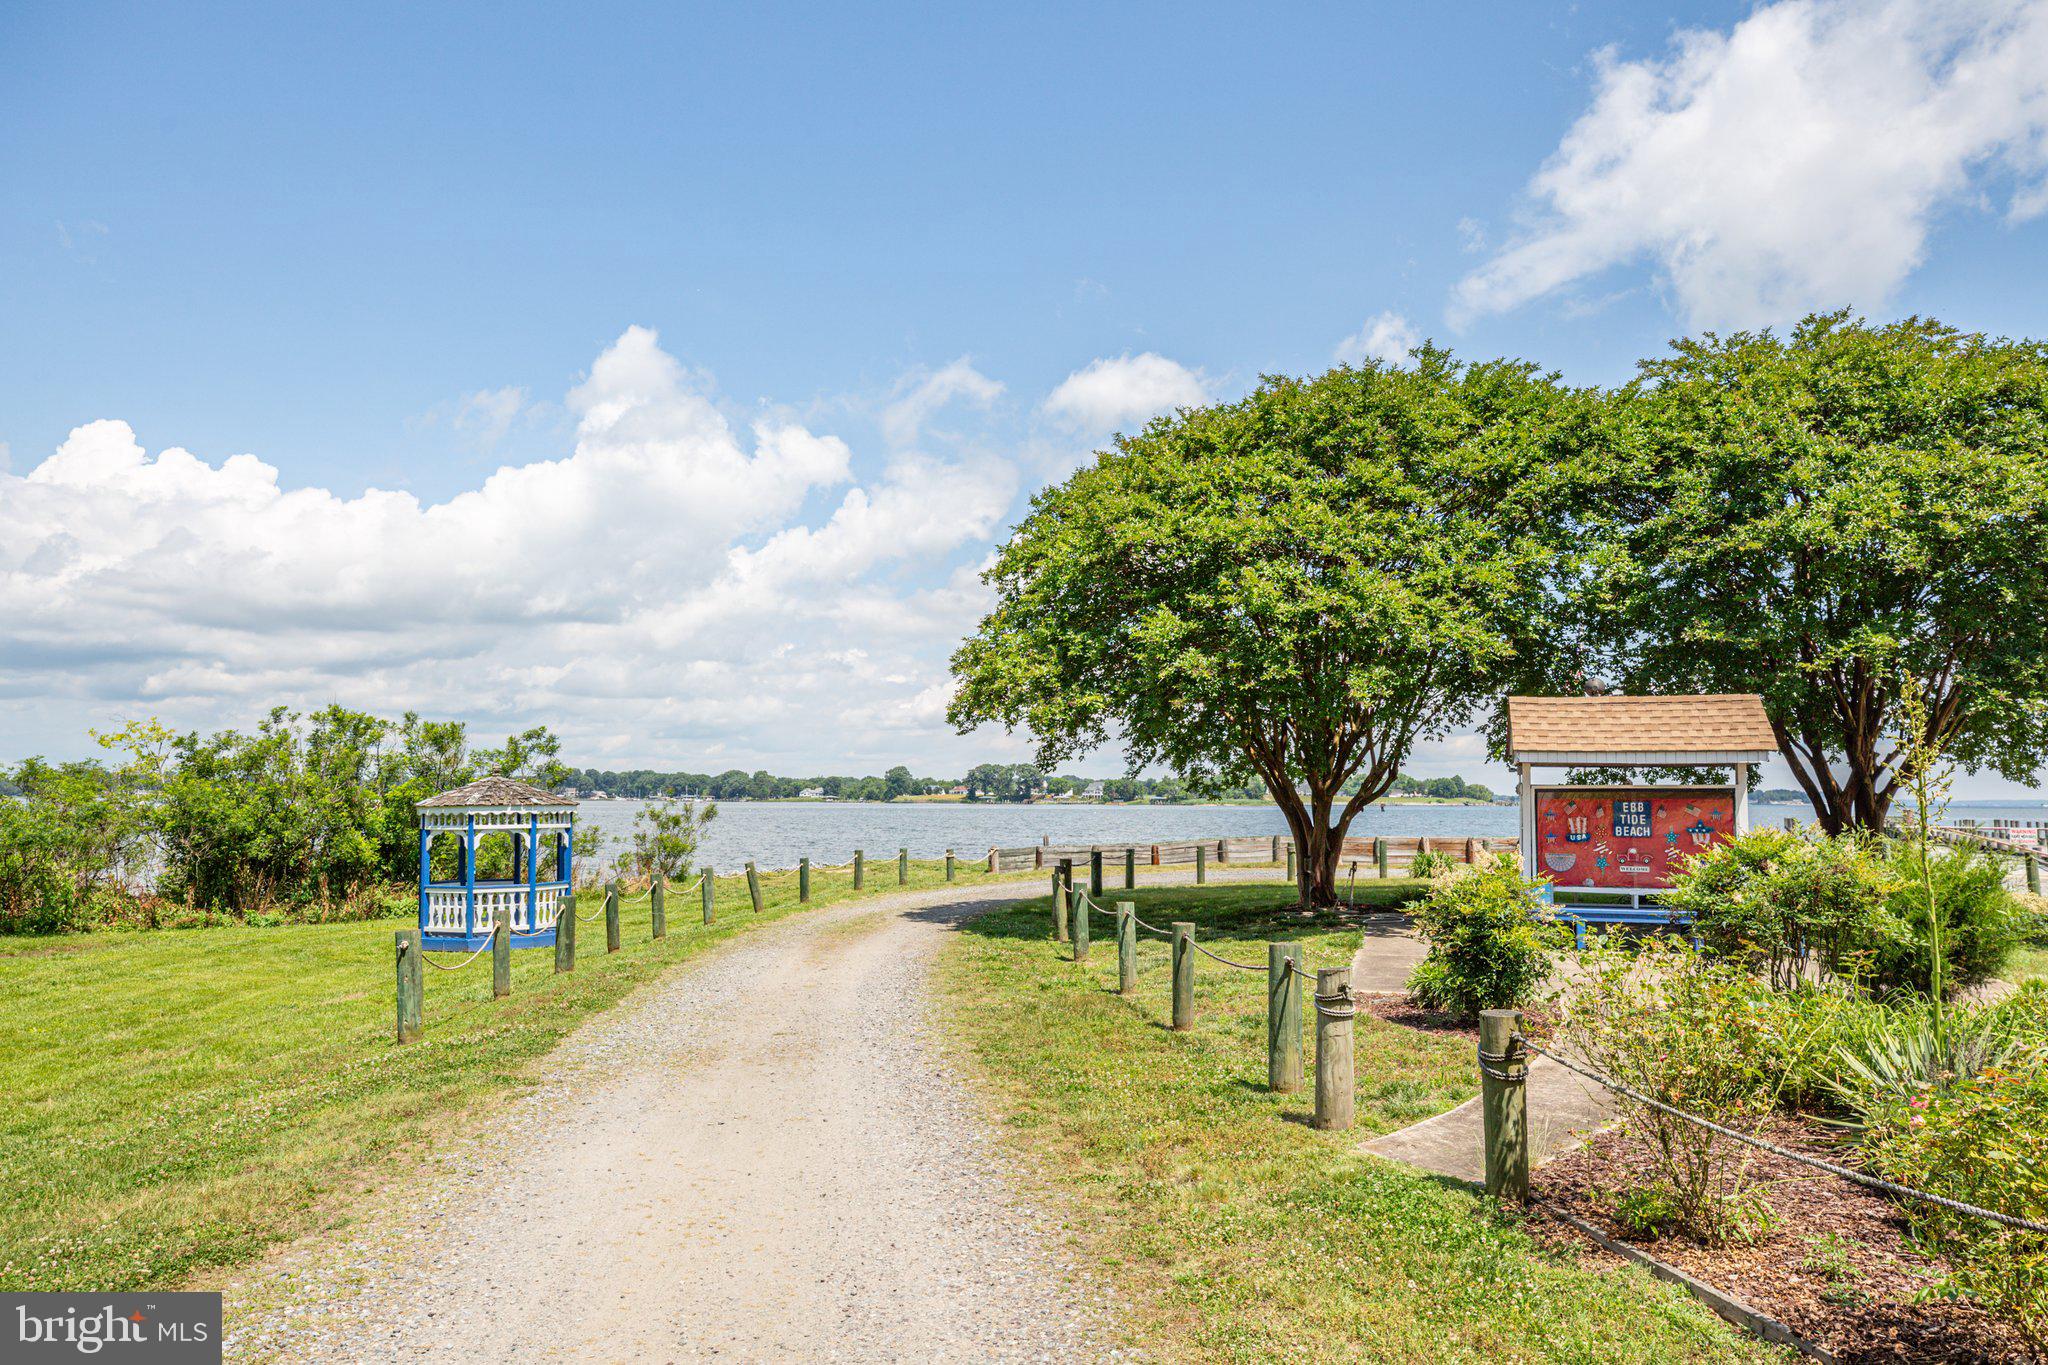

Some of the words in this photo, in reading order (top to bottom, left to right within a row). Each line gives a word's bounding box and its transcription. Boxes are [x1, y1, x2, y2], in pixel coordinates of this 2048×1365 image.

[1623, 802, 1644, 812] EBB
[1620, 815, 1646, 824] TIDE
[1615, 826, 1651, 837] BEACH
